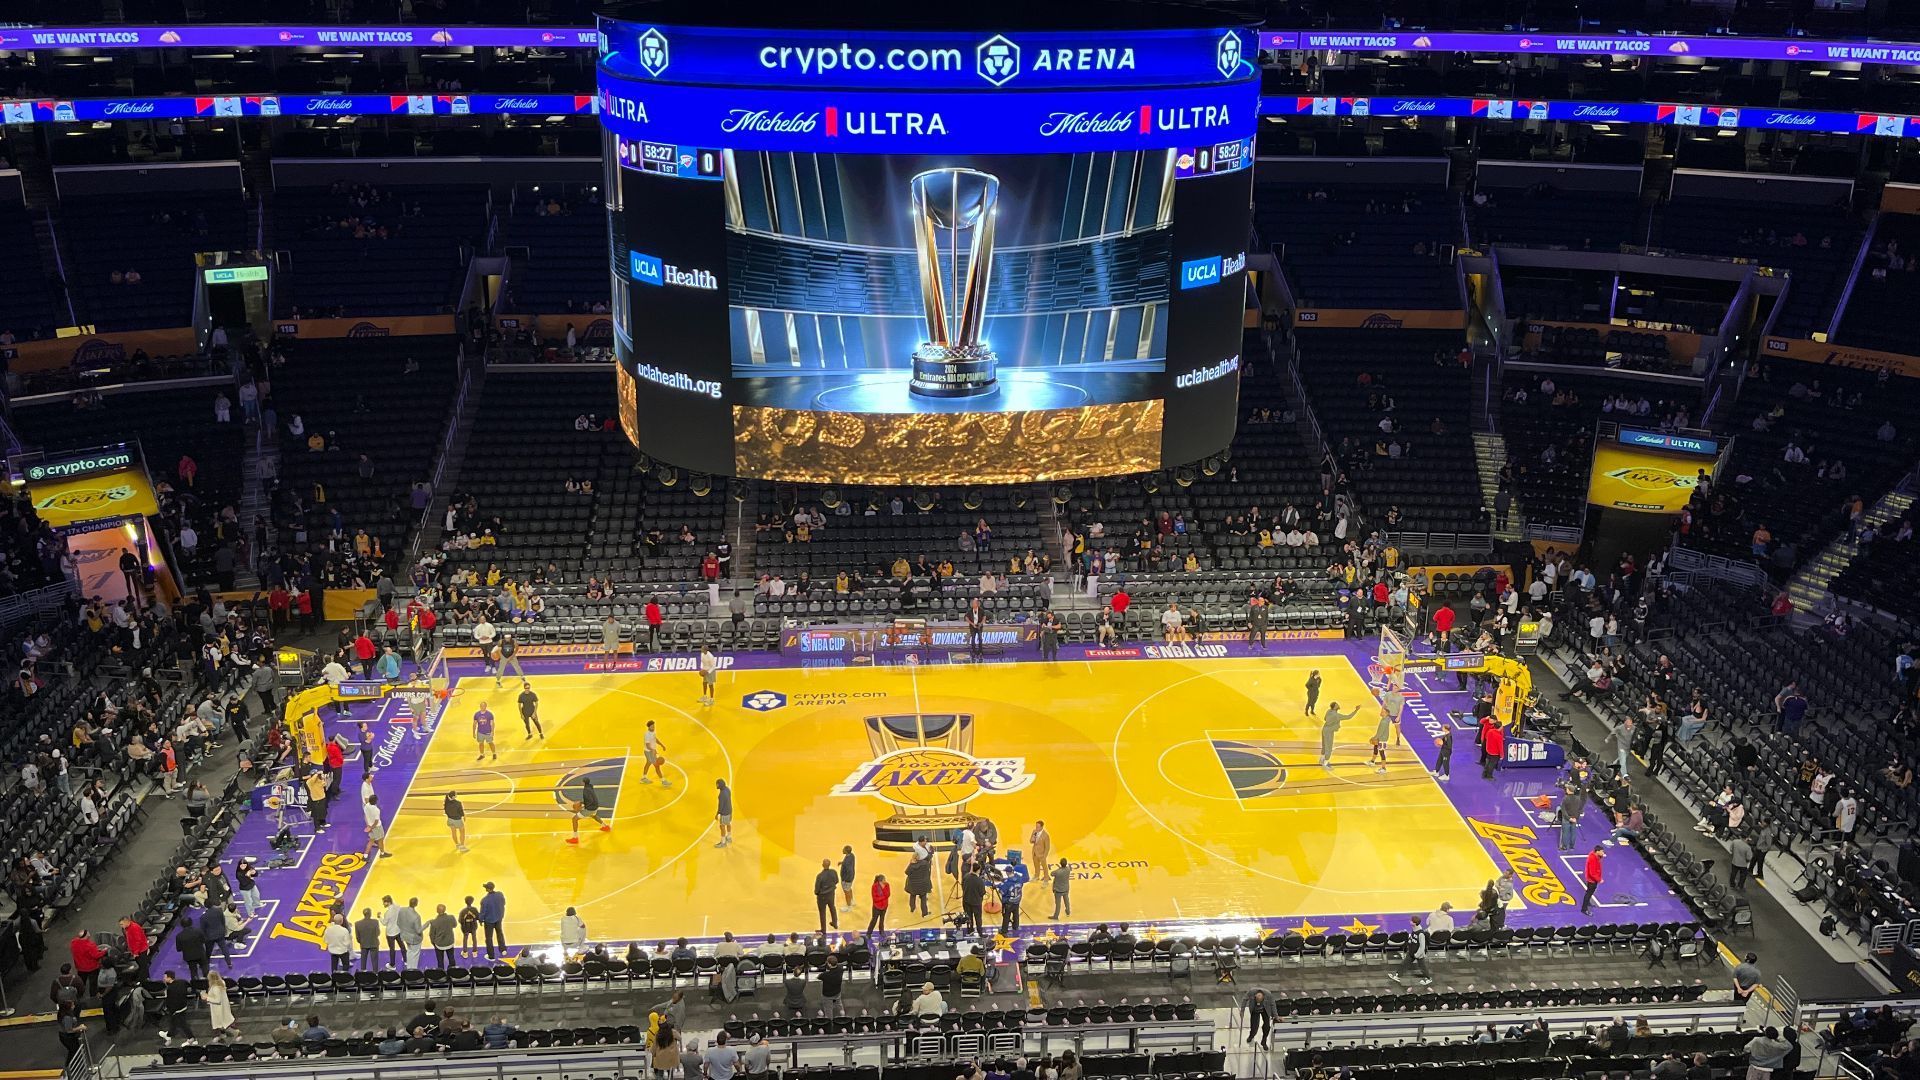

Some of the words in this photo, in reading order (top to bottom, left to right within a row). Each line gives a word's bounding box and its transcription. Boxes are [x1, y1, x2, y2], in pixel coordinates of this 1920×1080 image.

[33, 33, 55, 44] WE
[57, 33, 96, 43] WANT
[99, 32, 139, 43] TACOS
[318, 31, 338, 41] WE
[339, 31, 375, 41] WANT
[377, 31, 413, 42] TACOS
[578, 33, 597, 42] WE
[1310, 36, 1327, 46] WE
[1329, 36, 1361, 46] WANT
[1362, 36, 1396, 47] TACOS
[1556, 40, 1577, 50] WE
[1578, 40, 1613, 51] WANT
[1614, 40, 1650, 51] TACOS
[760, 43, 961, 74] crypto.com
[1828, 46, 1849, 58] WE
[1850, 47, 1889, 59] WANT
[1033, 49, 1135, 71] ARENA
[104, 102, 154, 114] Michelob
[306, 99, 353, 110] Michelob
[495, 98, 538, 110] Michelob
[609, 95, 648, 123] ULTRA
[1393, 100, 1436, 111] Michelob
[1573, 105, 1620, 116] Michelob
[721, 109, 819, 133] Michelob
[846, 112, 946, 135] ULTRA
[1040, 111, 1135, 136] Michelob
[1158, 105, 1230, 129] ULTRA
[1766, 113, 1817, 125] Michelob
[631, 144, 636, 163] 0
[644, 145, 672, 160] 58:27
[704, 153, 713, 172] 0
[1200, 150, 1208, 169] 0
[1219, 143, 1240, 159] 58:27
[662, 164, 674, 173] 1ST
[635, 258, 659, 279] UCLA
[664, 264, 719, 290] Health
[1188, 264, 1217, 282] UCLA
[1300, 313, 1316, 321] 103
[1768, 341, 1786, 350] 105
[945, 364, 957, 373] 2024
[638, 361, 723, 398] uclahealth.org
[920, 371, 946, 382] Emirates
[957, 373, 966, 382] CUP
[1671, 439, 1701, 450] ULTRA
[47, 454, 130, 477] crypto.com
[812, 638, 829, 651] NBA
[829, 637, 846, 651] CUP
[1160, 645, 1195, 658] NBA
[1198, 645, 1227, 657] CUP
[664, 658, 696, 670] NBA
[794, 691, 887, 699] crypto.com
[1406, 699, 1445, 738] ULTRA
[933, 759, 1017, 767] ANGELES
[840, 762, 1027, 793] LAKERS
[1467, 816, 1576, 906] LAKERS
[270, 851, 371, 951] LAKERS
